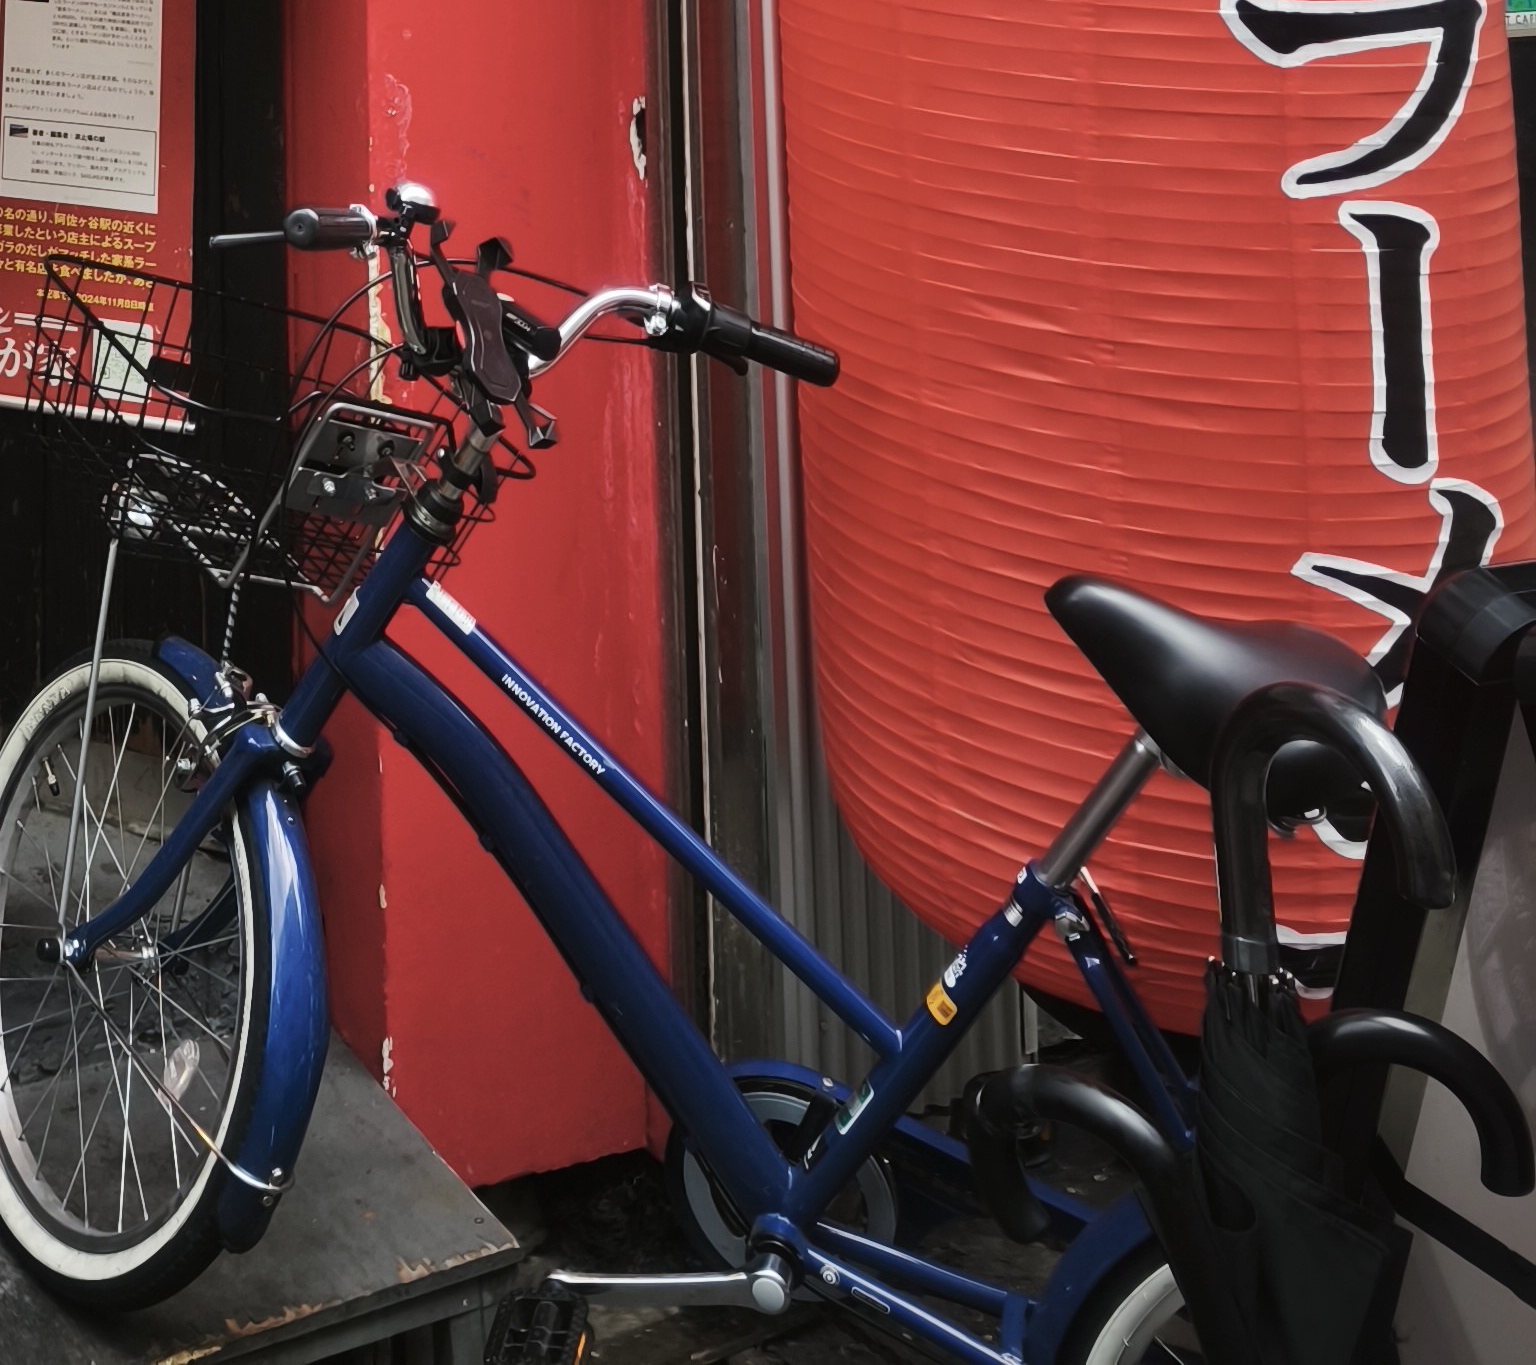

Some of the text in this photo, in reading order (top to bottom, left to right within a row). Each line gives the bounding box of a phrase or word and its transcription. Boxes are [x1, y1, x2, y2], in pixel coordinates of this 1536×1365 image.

[1515, 13, 1536, 27] CAF
[501, 673, 606, 775] INNOVATION FACTORY
